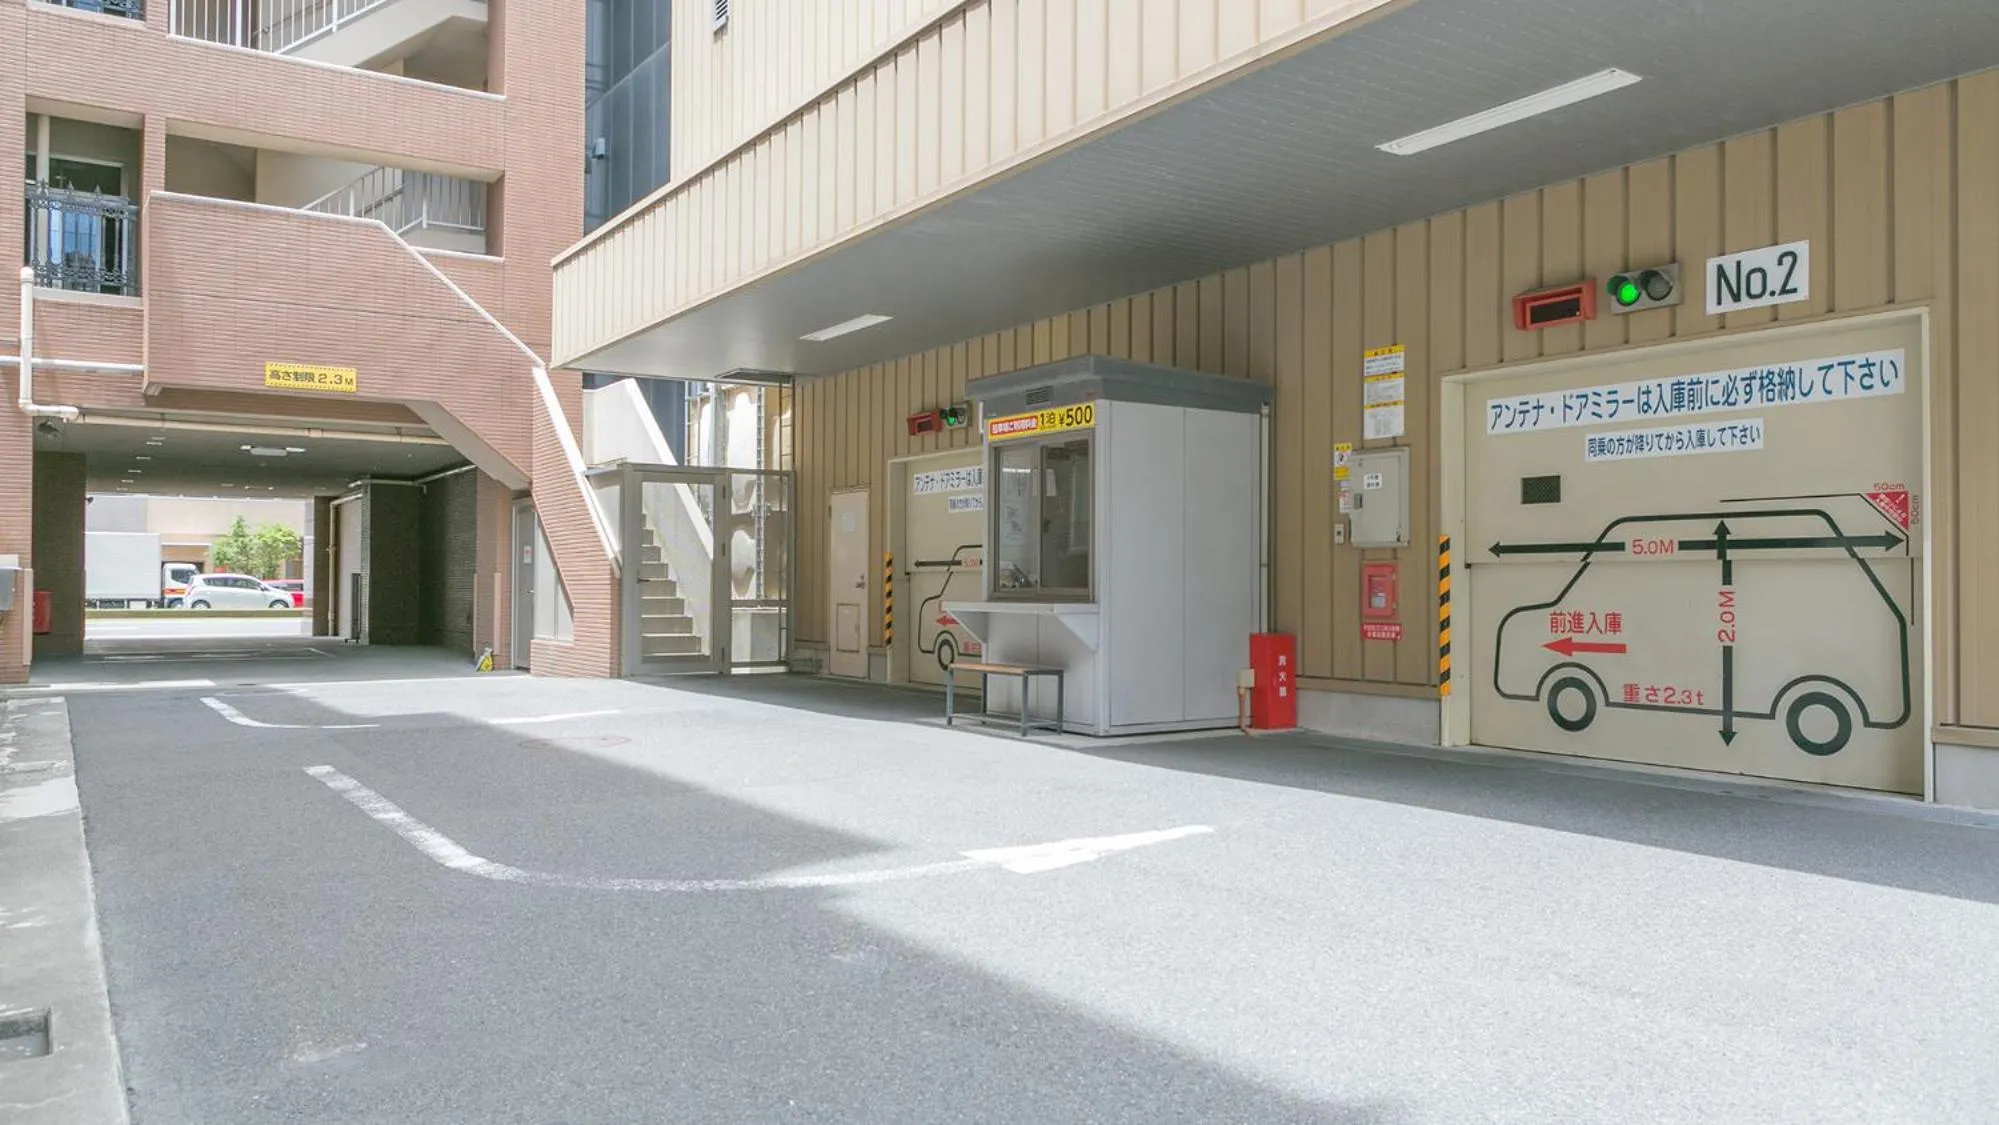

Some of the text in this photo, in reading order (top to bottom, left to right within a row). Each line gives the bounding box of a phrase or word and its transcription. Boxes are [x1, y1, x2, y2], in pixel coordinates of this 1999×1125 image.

[1716, 251, 1798, 306] No.2
[1490, 357, 1899, 430] アンテナ・ドアミラーは入庫前に必ず格納して下さい
[1632, 538, 1674, 555] 5.0M
[1549, 611, 1622, 635] 前進入庫
[1717, 590, 1736, 643] 2.0M
